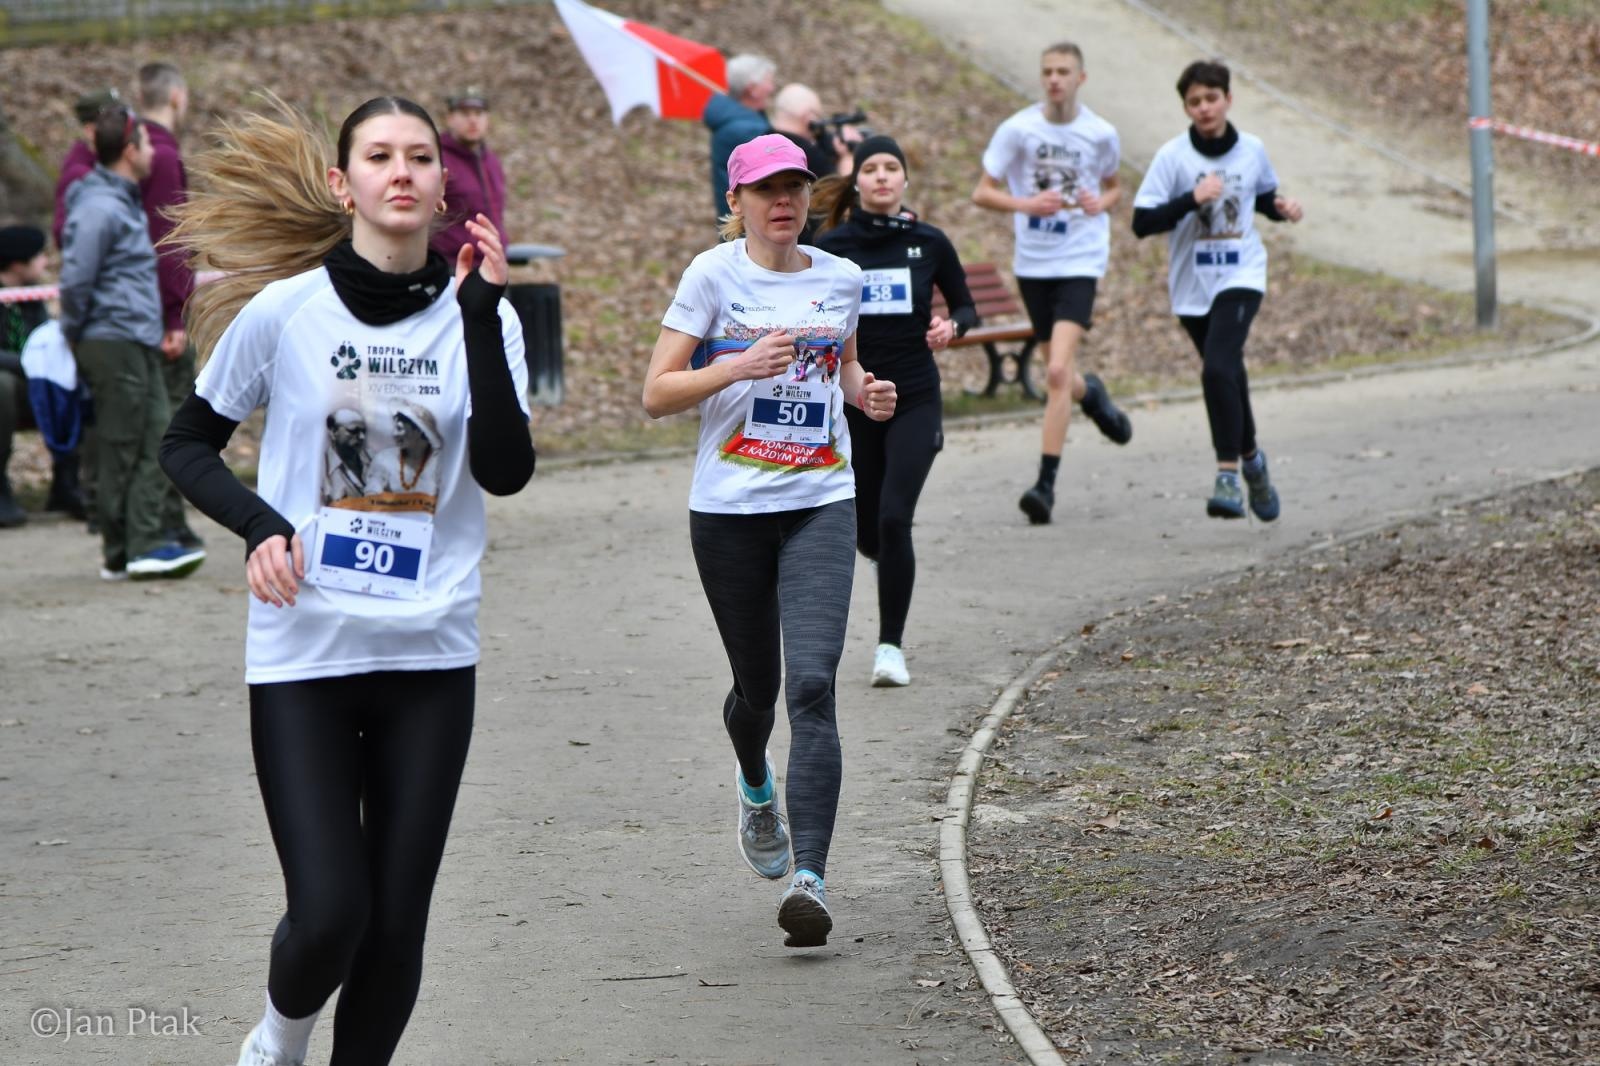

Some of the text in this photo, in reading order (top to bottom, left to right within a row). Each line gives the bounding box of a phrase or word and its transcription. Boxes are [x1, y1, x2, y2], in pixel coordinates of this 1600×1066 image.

[869, 285, 893, 301] 58
[367, 346, 405, 356] TROPEM
[368, 357, 438, 376] WILCZYM
[785, 389, 812, 399] WILCZYM
[777, 402, 807, 426] 50
[738, 443, 747, 453] Z
[748, 445, 792, 463] KAŻDYM
[354, 540, 395, 574] 90
